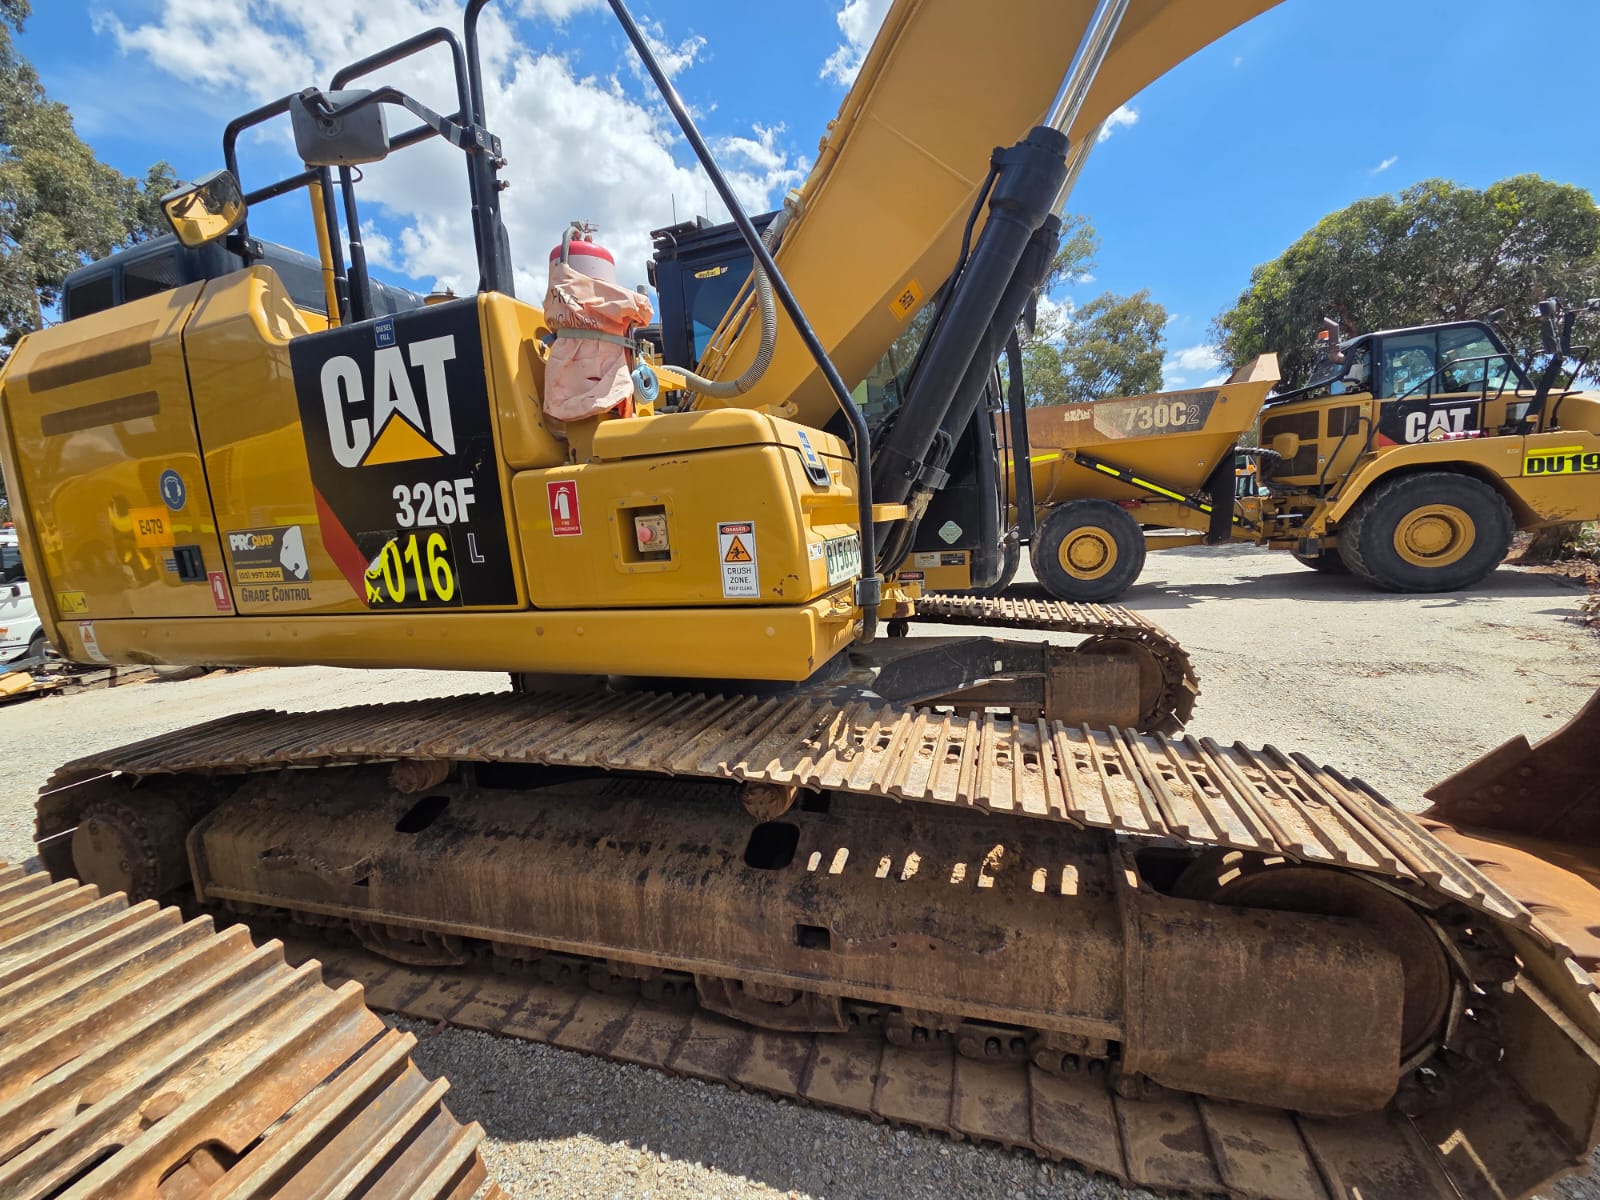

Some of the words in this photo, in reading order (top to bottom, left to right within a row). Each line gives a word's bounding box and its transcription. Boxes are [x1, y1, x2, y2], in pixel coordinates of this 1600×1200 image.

[375, 324, 392, 333] DIESEL
[379, 332, 391, 341] FILL
[320, 334, 457, 468] CAT
[1122, 402, 1200, 430] 730C2
[1404, 407, 1471, 443] CAT
[1527, 453, 1600, 474] DU19
[392, 477, 476, 527] 326F
[138, 518, 164, 535] E479
[228, 533, 274, 551] PROQUIP
[466, 533, 485, 564] L
[727, 567, 751, 575] CRUSH
[241, 587, 271, 602] GRADE
[272, 586, 312, 601] CONTROL
